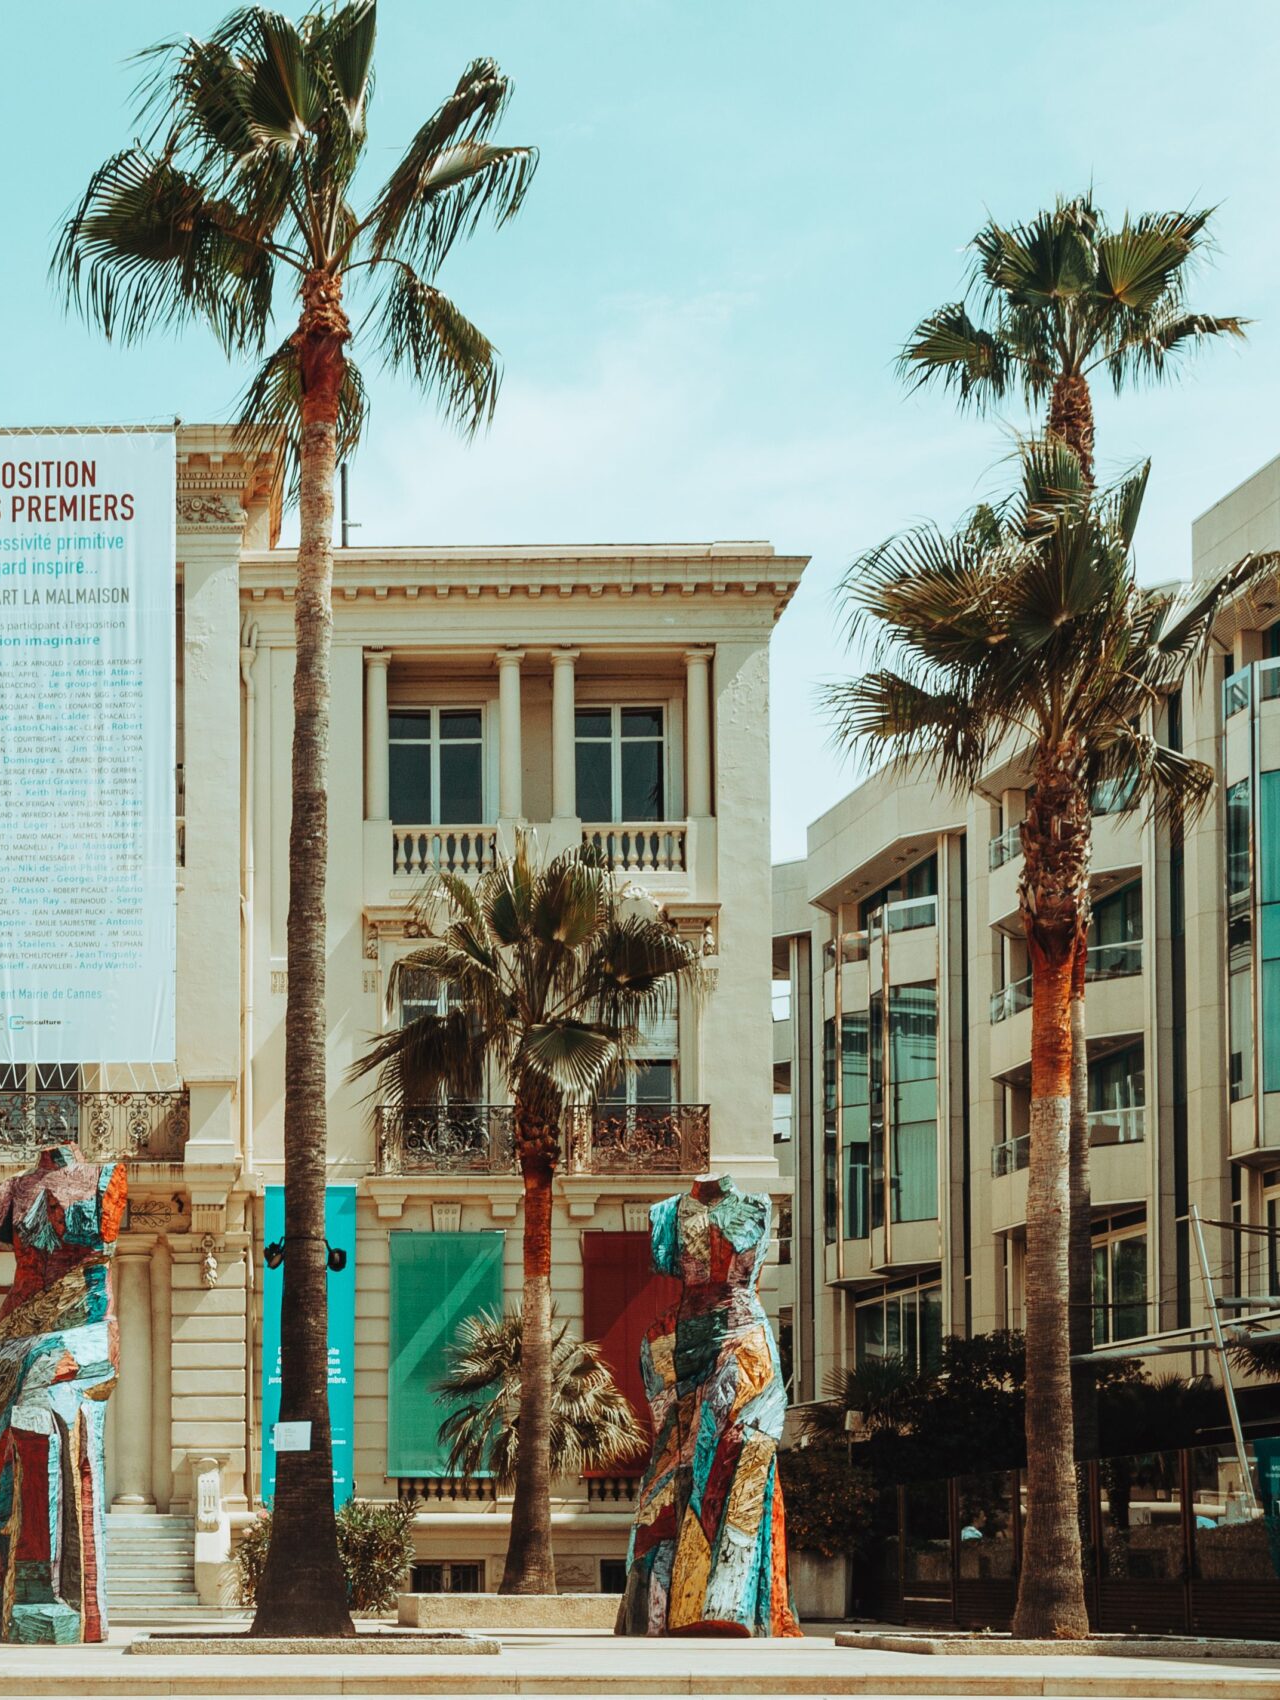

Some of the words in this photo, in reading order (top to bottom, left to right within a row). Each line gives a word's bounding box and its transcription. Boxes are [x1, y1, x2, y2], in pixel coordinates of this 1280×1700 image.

[11, 494, 135, 522] PREMIERS
[57, 530, 124, 554] primitive
[24, 588, 42, 605] LA
[46, 587, 130, 604] MALMAISON
[8, 621, 60, 632] participant
[25, 634, 100, 648] imaginaire
[18, 988, 49, 1000] Mairie
[52, 988, 64, 999] de
[67, 988, 102, 999] Cannes
